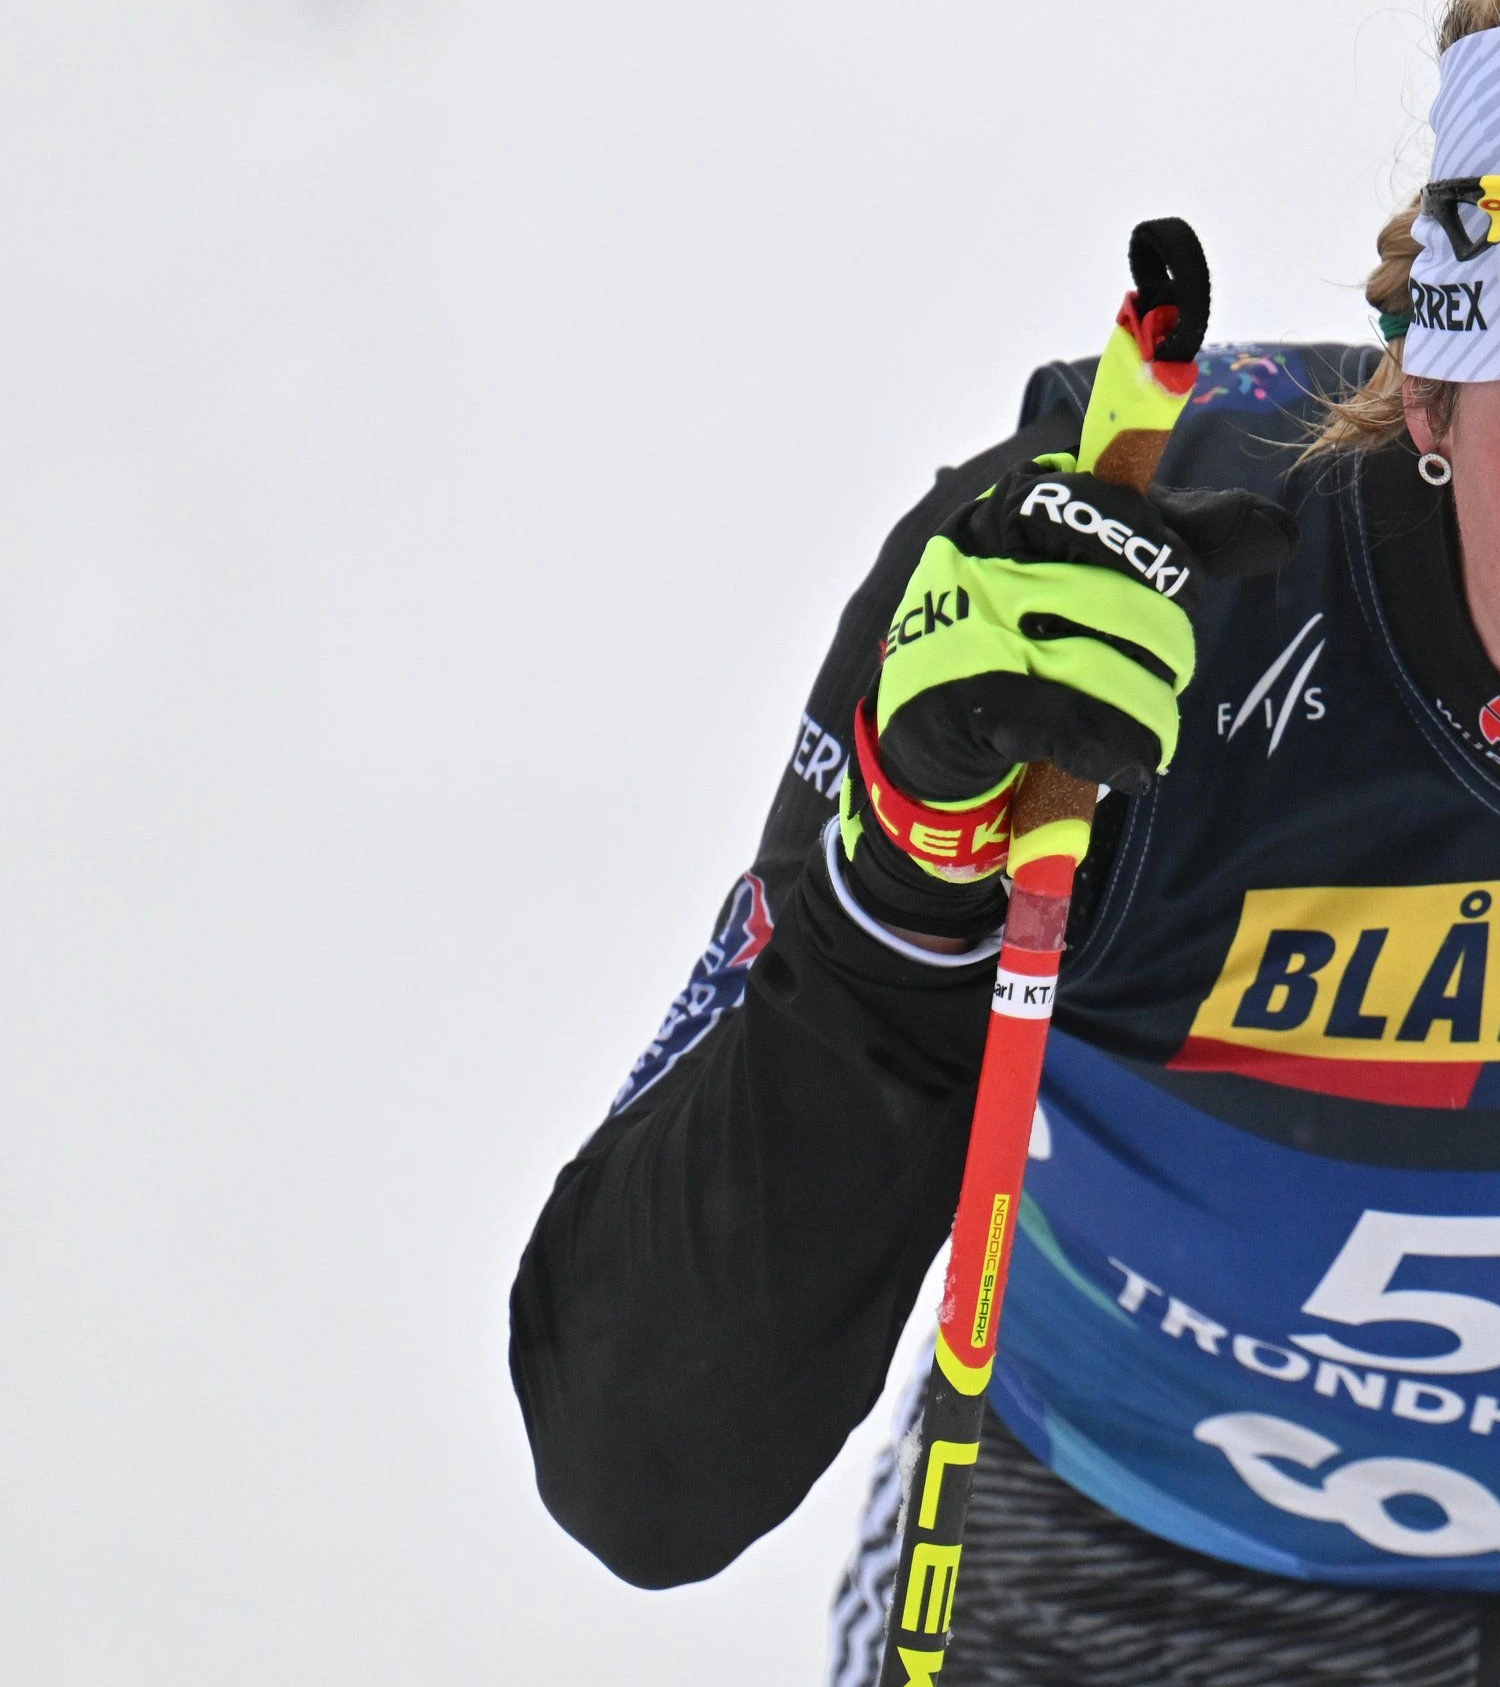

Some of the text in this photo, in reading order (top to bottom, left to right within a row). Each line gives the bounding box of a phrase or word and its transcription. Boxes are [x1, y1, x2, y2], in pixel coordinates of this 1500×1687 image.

[793, 711, 850, 801] ER
[975, 1199, 1007, 1344] NORDIC SHARK
